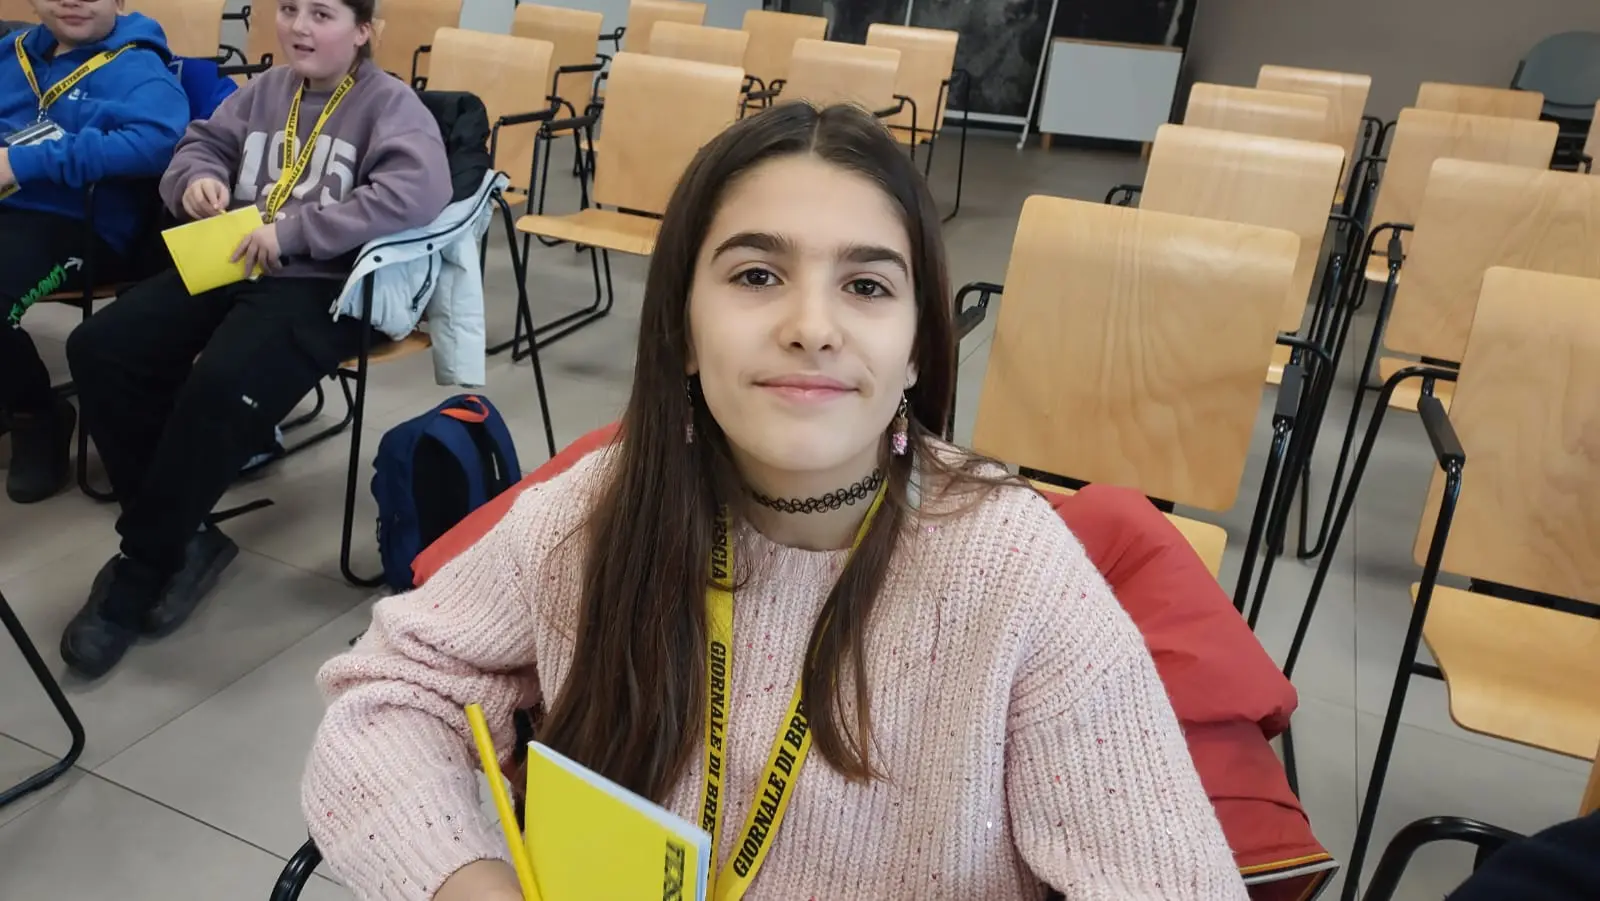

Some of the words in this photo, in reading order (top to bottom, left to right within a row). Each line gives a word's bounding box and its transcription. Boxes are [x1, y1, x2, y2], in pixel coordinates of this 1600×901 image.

[710, 641, 726, 752] GIORNALE
[708, 752, 721, 779] DI
[733, 772, 787, 878] GIORNALE
[775, 749, 797, 777] DI
